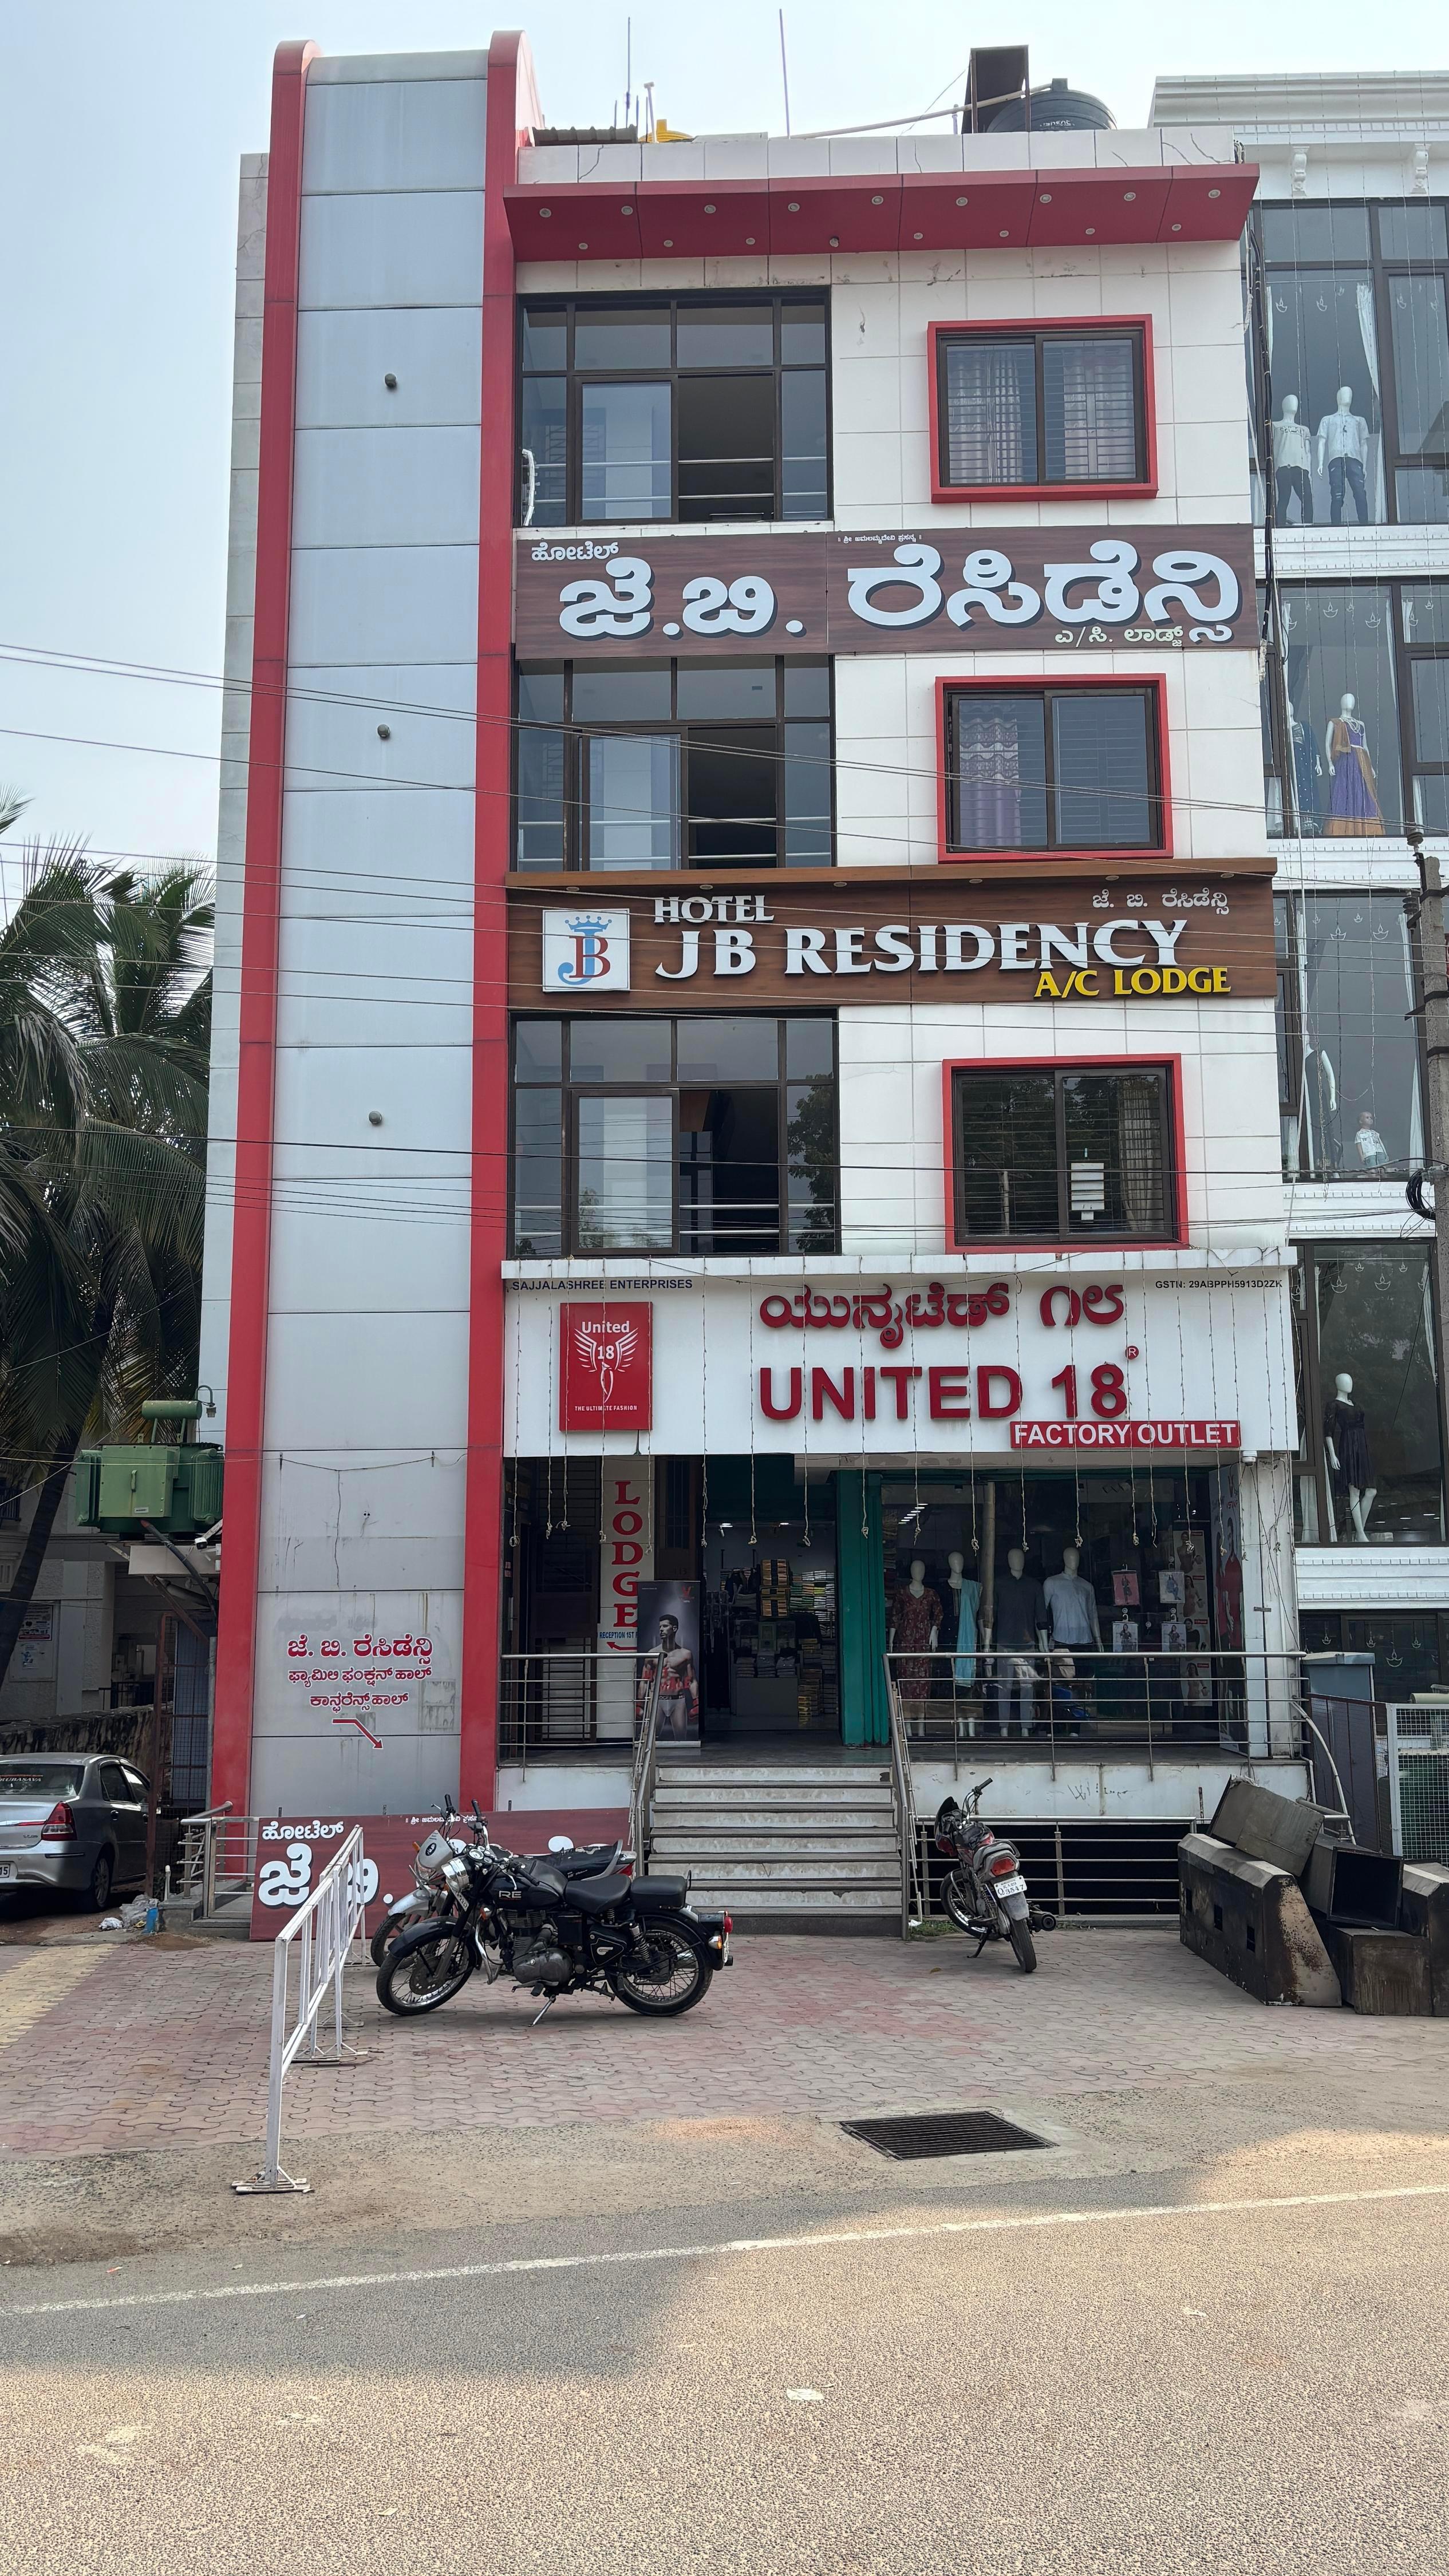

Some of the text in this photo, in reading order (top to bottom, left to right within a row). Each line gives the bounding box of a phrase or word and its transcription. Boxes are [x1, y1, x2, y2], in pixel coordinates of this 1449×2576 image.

[531, 541, 619, 561] ಹೋಟೆಲ್
[847, 539, 1239, 643] ರೆಸಿಡೆನ್ಸಿ
[654, 895, 774, 924] HOTEL
[1162, 888, 1230, 915] ರೆಸಿಡೆನ್ಸಿ
[655, 919, 1188, 979] JB RESIDENCY
[1034, 967, 1231, 998] A/C LODGE
[512, 1279, 693, 1291] SAJJALASHREE ENTERPRISES
[1155, 1281, 1186, 1289] GSTN:
[582, 1320, 630, 1333] United
[597, 1345, 614, 1360] 18
[760, 1365, 1023, 1421] UNITED
[1052, 1364, 1127, 1419] 18
[1014, 1423, 1238, 1445] FACTORY OUTLET
[611, 1481, 643, 1627] LODGE
[287, 1633, 433, 1665] ಜೆ. ಬಿ. ರೆಸಿಡೆನ್ಸಿ
[394, 1666, 432, 1680] ಹಾಲ್
[372, 1692, 409, 1706] ಹಾಲ್
[262, 1820, 344, 1840] ಹೋಟೆಲ್
[499, 1890, 522, 1898] RE
